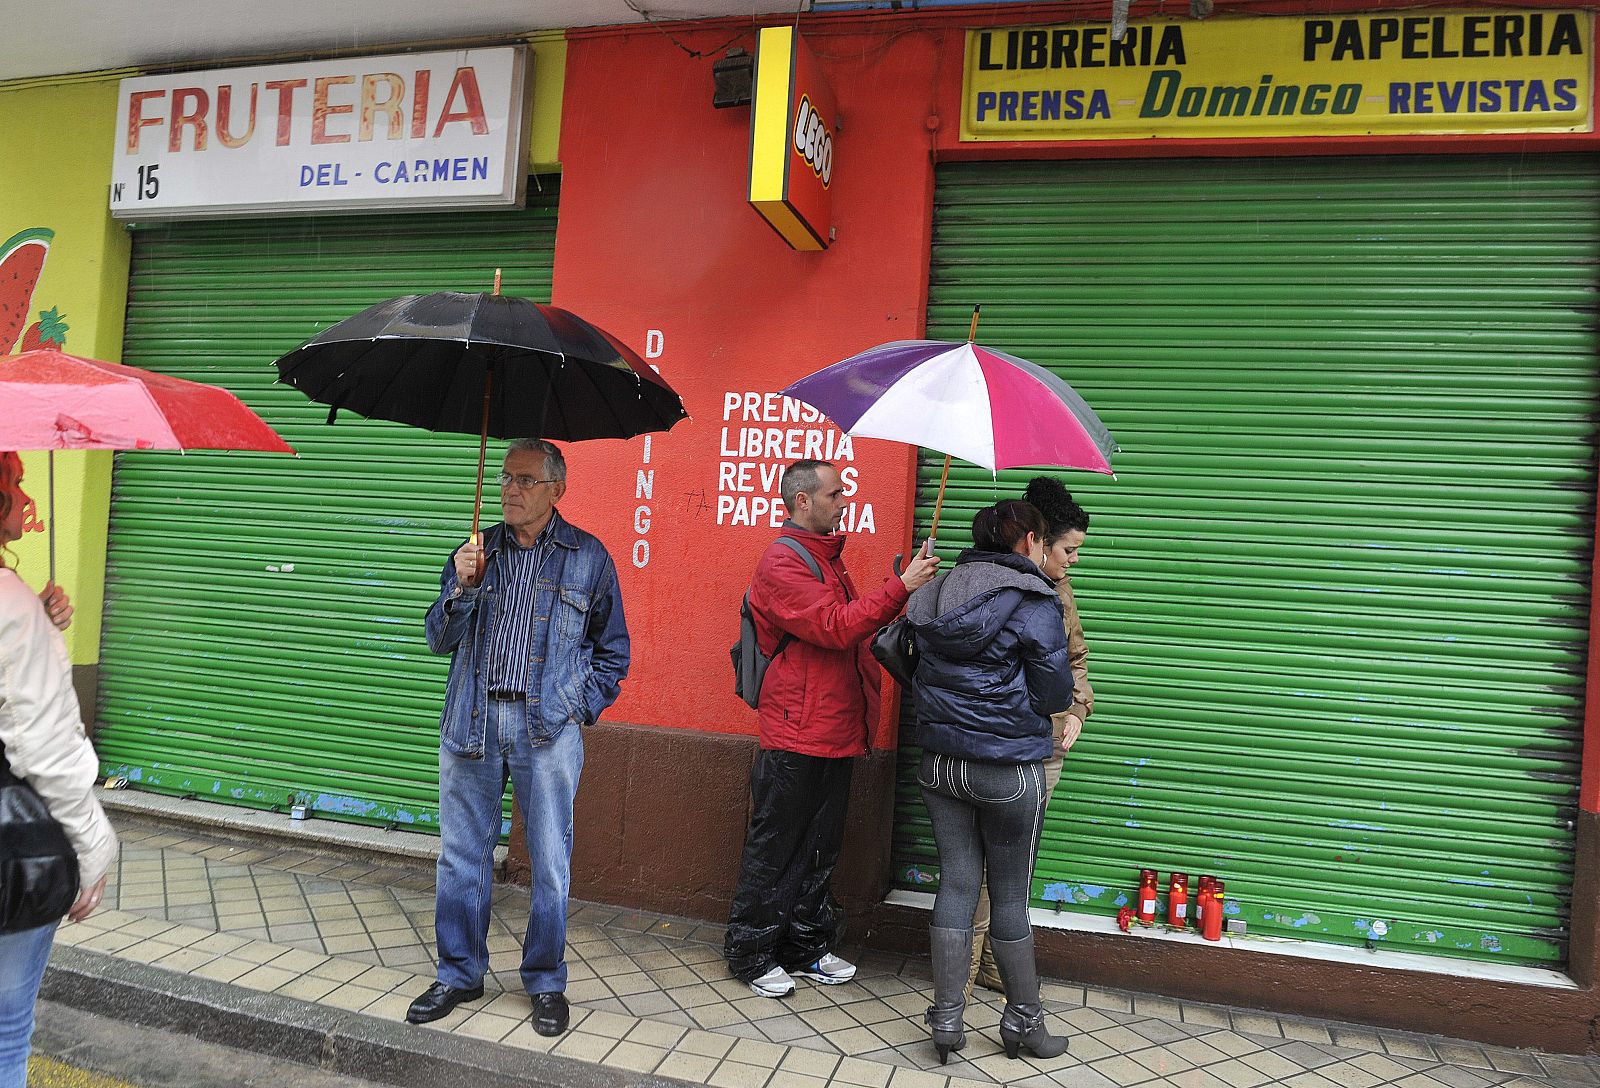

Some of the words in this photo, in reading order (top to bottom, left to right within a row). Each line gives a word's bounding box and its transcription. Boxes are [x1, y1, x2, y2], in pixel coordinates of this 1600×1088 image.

[979, 25, 1186, 71] LIBRERIA
[1303, 13, 1583, 62] PAPELERIA
[126, 66, 489, 155] FRUTERIA
[976, 89, 1111, 122] PRENSA
[1388, 78, 1578, 114] REVISTAS
[794, 95, 832, 188] LEGO
[137, 164, 160, 200] 15
[374, 156, 489, 184] CARMEN
[723, 391, 826, 423] PRENS
[632, 329, 665, 569] DINGO
[720, 427, 855, 461] LIBRERIA
[718, 461, 859, 497] REVIS
